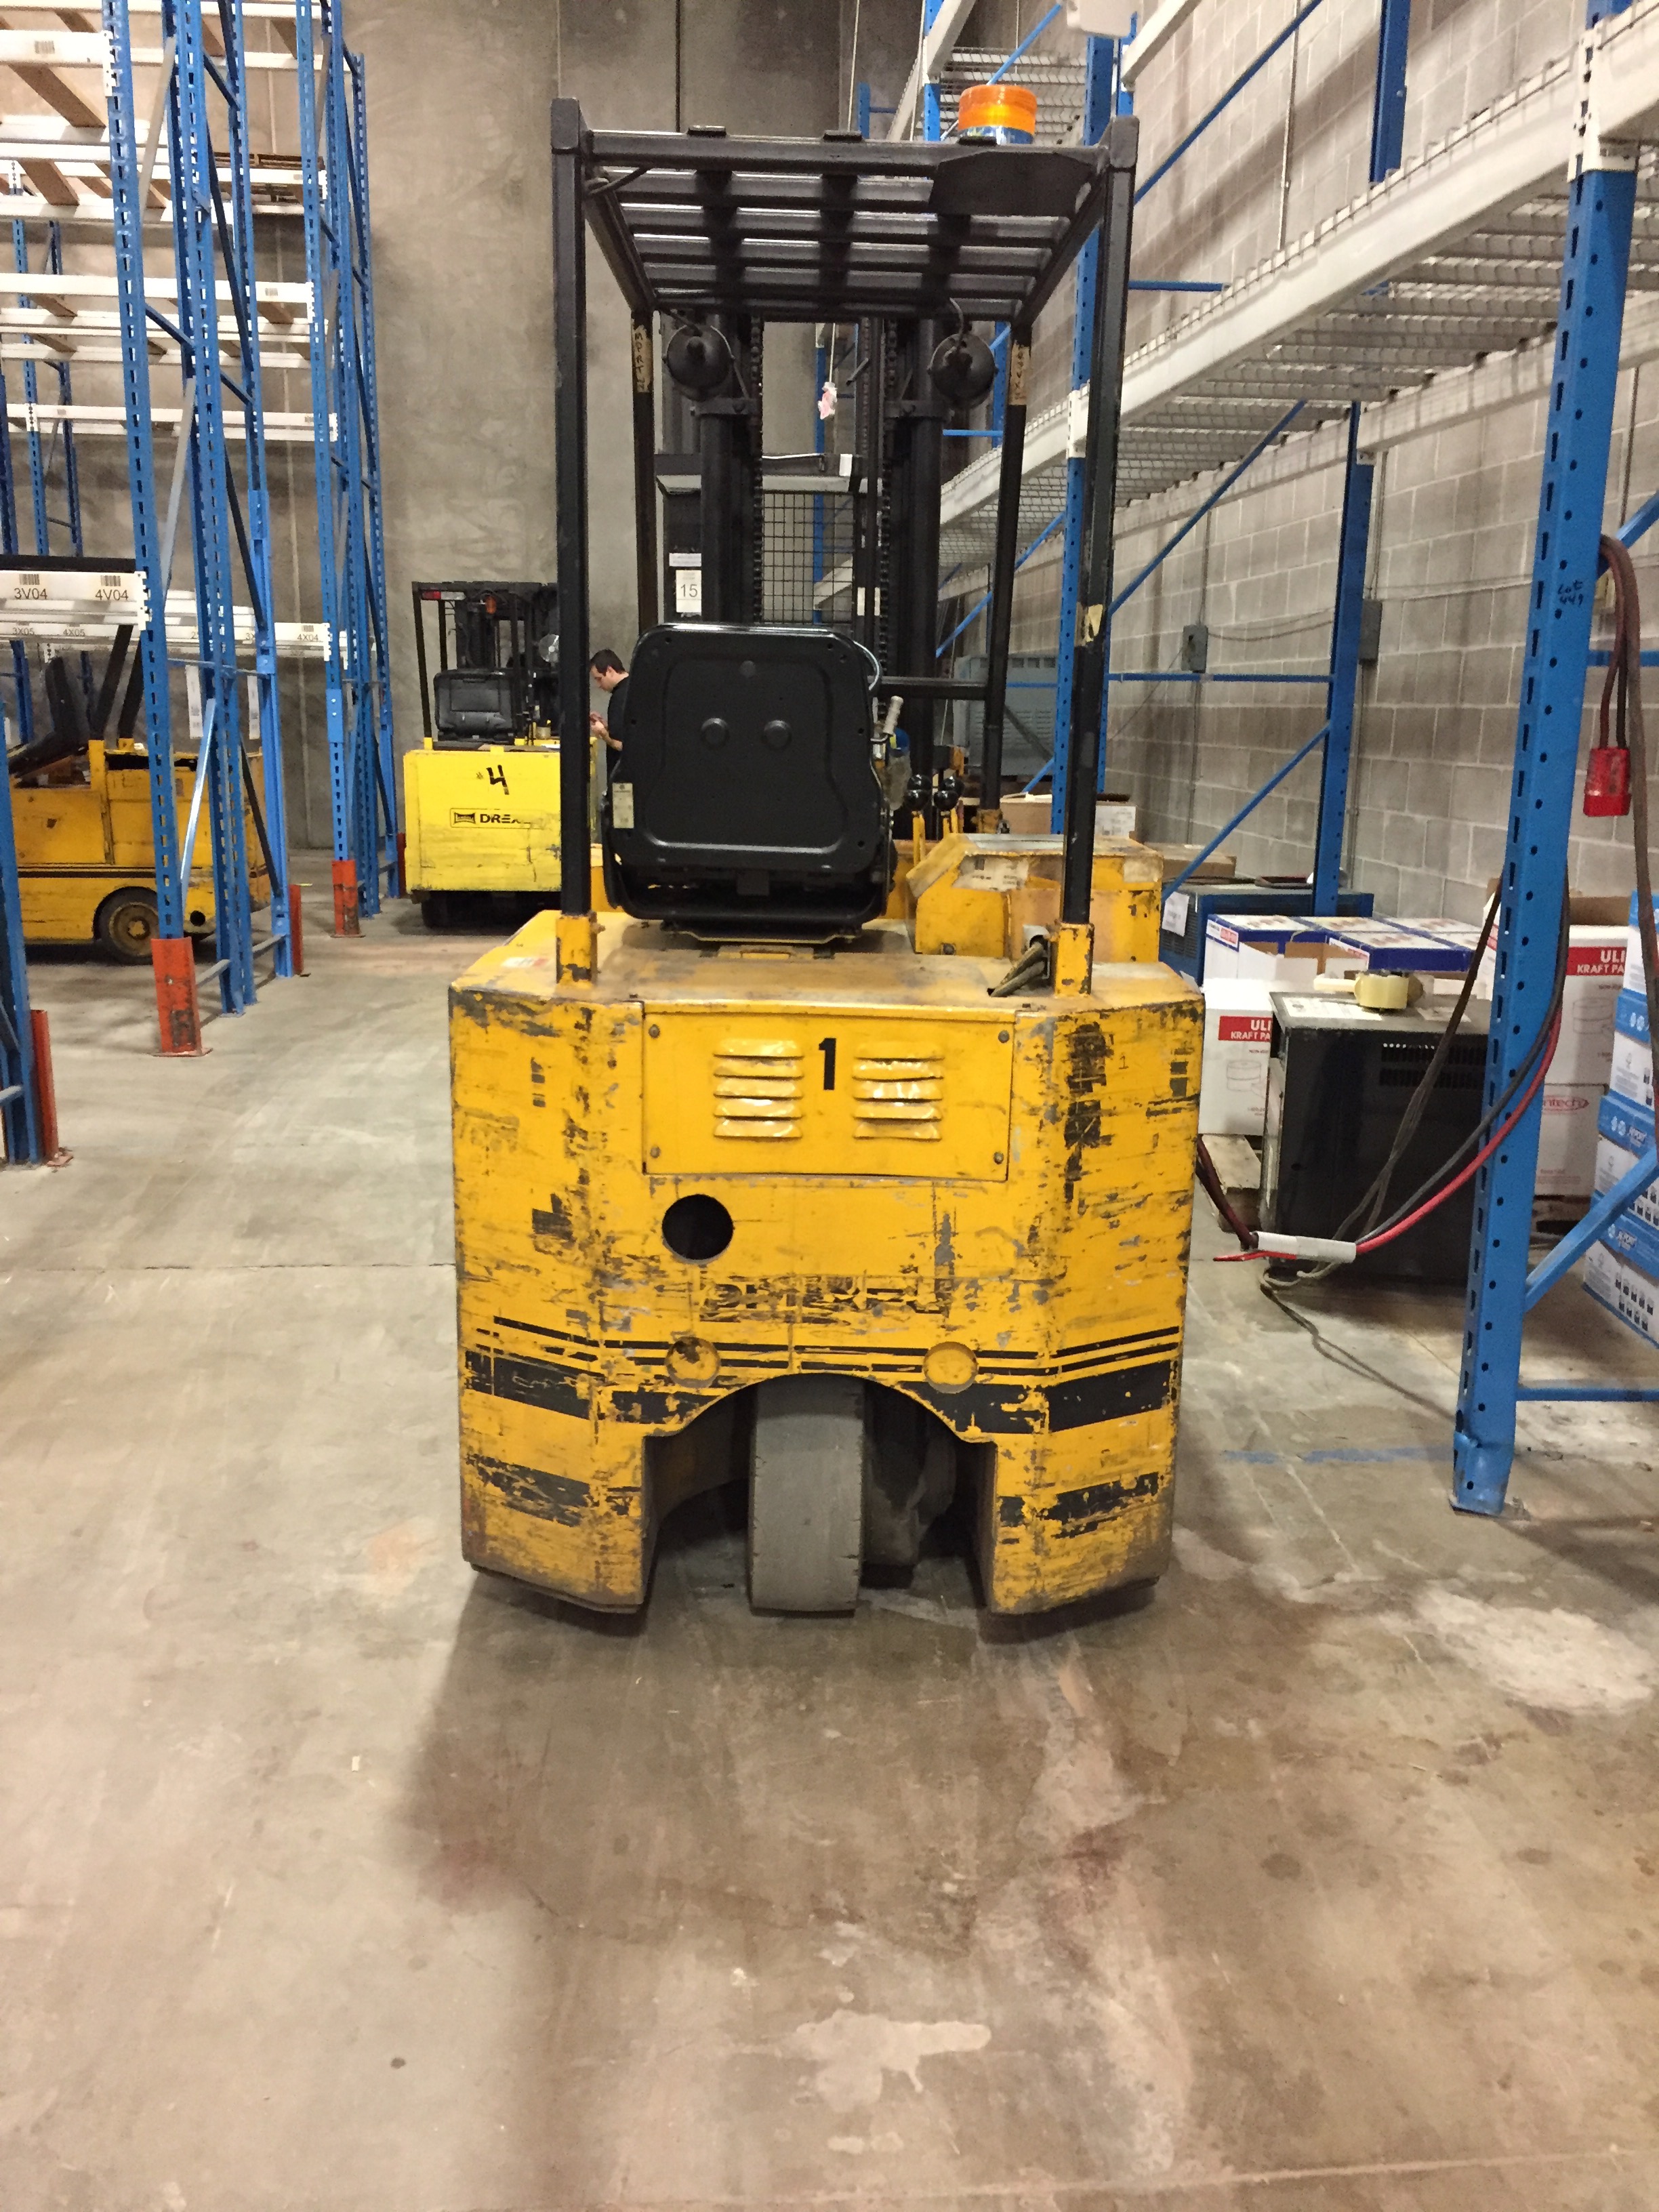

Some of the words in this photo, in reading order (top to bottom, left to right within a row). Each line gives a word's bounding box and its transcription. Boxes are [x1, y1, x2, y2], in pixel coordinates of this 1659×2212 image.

[14, 588, 48, 600] 3V04
[95, 589, 129, 601] 4V04
[680, 583, 699, 598] 15
[63, 628, 85, 637] 4X05
[297, 634, 319, 642] 4X04
[1600, 949, 1625, 963] ULI
[1577, 964, 1610, 973] KRAFT
[1612, 964, 1624, 974] PA
[1250, 1019, 1271, 1031] ULI
[1231, 1031, 1258, 1040] KRAFT
[1260, 1031, 1271, 1040] PA
[819, 1038, 837, 1091] 1
